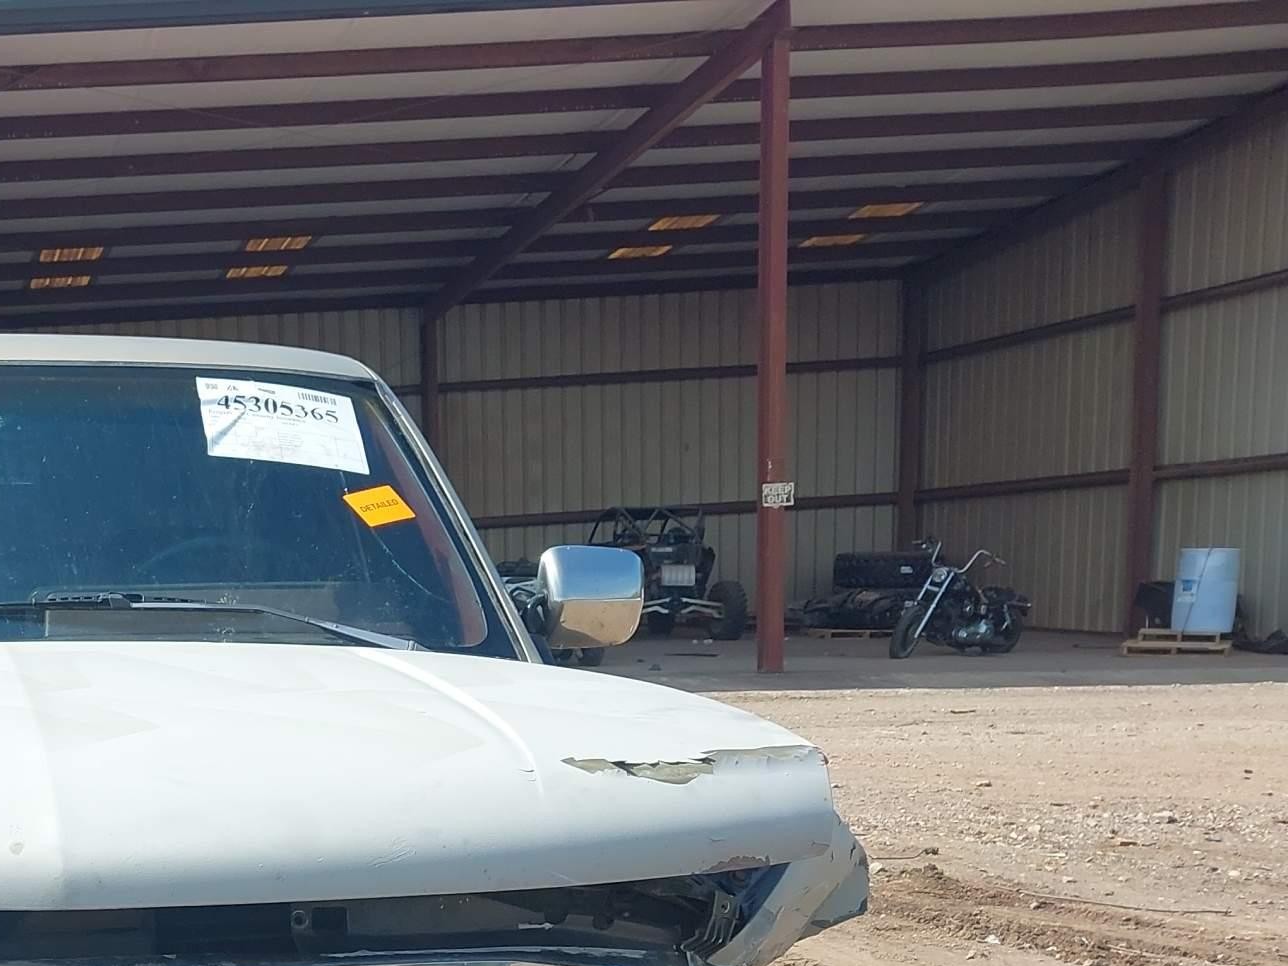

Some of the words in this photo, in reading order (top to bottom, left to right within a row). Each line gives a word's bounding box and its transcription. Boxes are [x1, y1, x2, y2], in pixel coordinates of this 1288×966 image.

[217, 395, 339, 423] 45305365
[764, 485, 792, 495] KEEP
[767, 494, 789, 504] OUT
[359, 499, 399, 513] DETAILED
